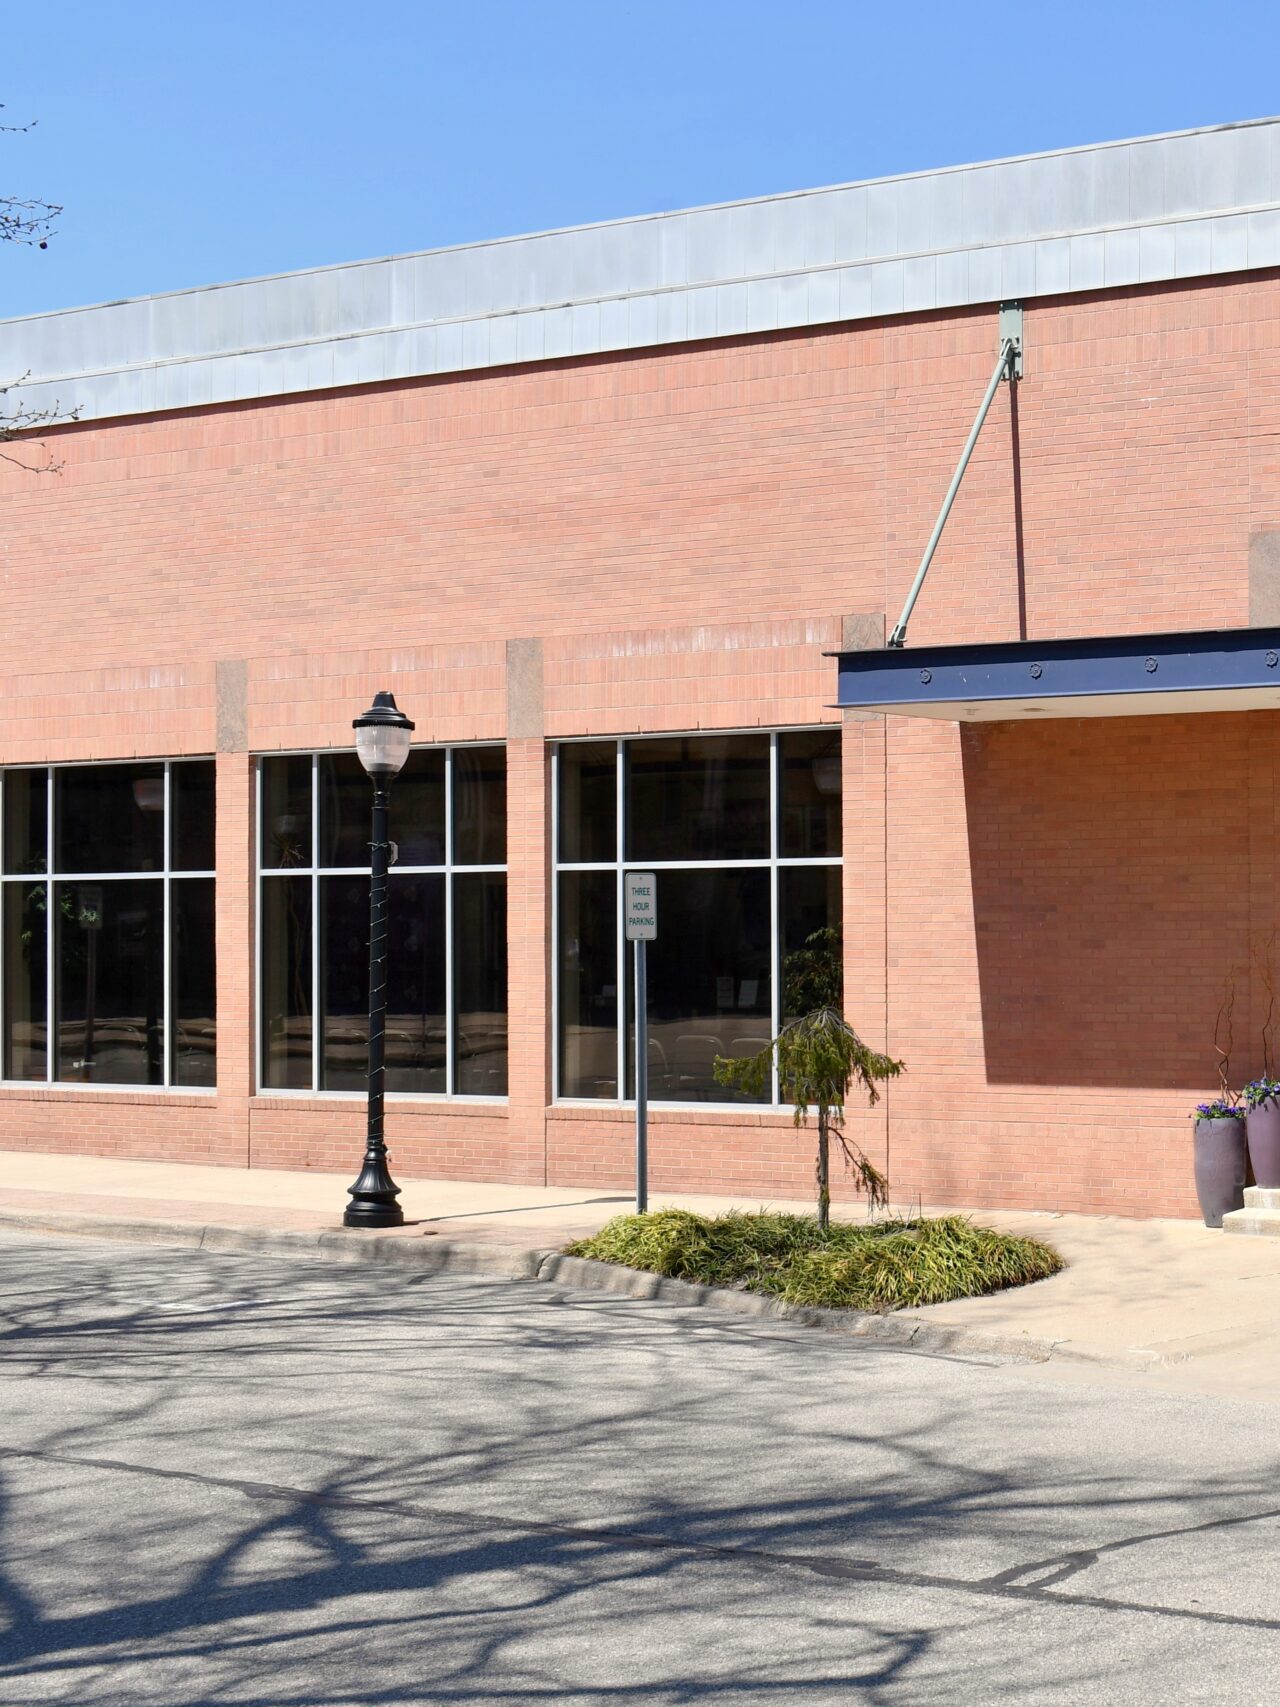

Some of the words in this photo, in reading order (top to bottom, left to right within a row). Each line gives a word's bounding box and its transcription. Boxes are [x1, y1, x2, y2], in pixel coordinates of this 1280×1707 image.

[632, 887, 651, 896] THREE
[633, 902, 649, 911] HOUR
[629, 917, 655, 926] PARKING
